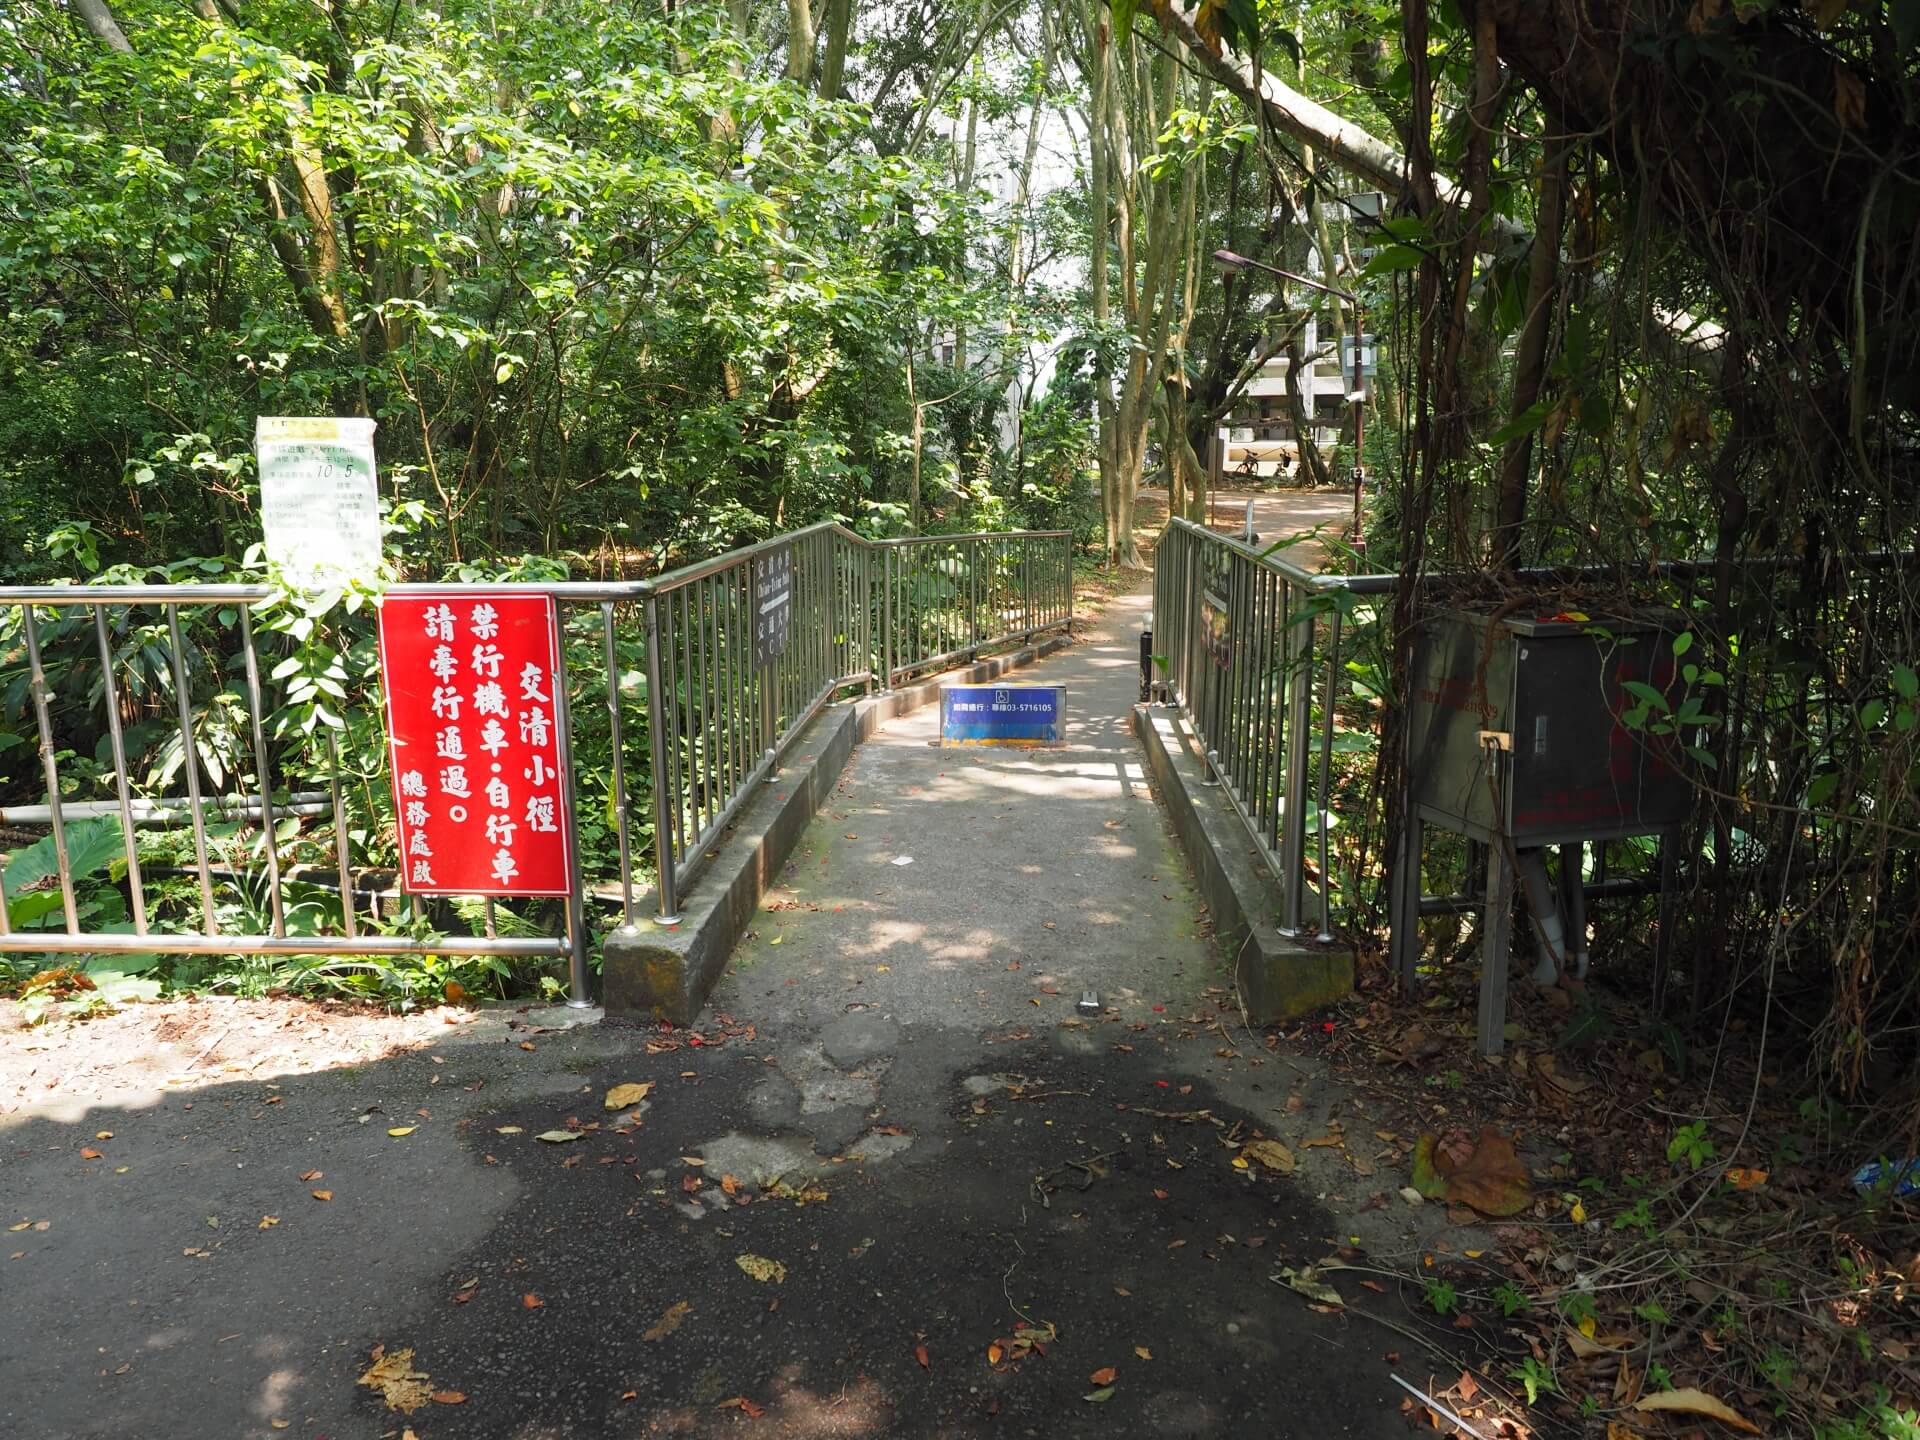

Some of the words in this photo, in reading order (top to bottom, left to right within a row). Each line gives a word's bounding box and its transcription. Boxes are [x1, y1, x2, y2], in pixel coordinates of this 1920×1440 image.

[344, 464, 354, 478] 5
[519, 661, 559, 833] 交清小徑
